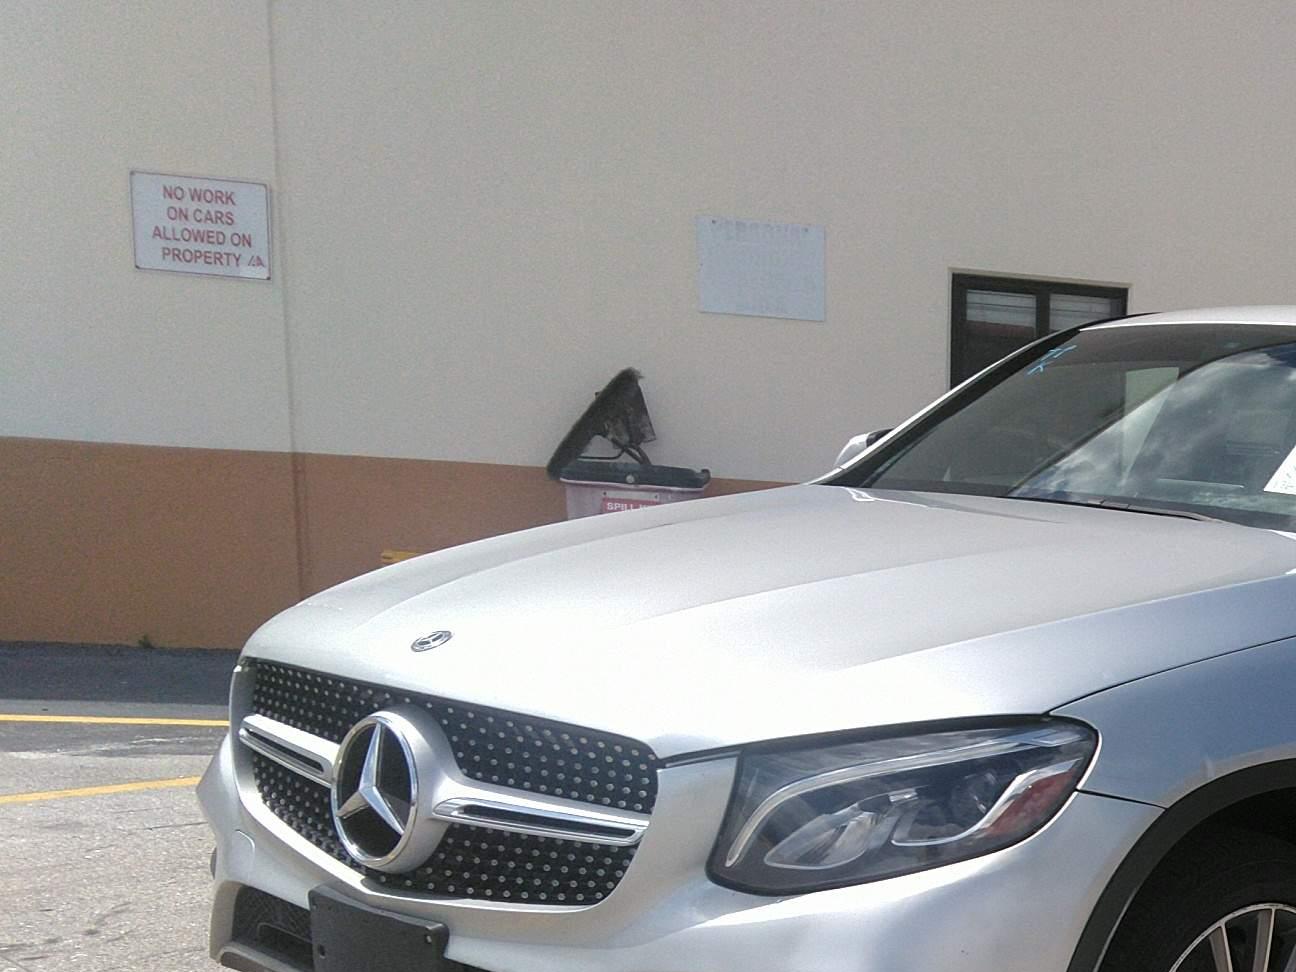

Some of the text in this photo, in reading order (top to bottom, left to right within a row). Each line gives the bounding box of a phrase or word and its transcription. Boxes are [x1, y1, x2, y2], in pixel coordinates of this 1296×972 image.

[162, 185, 236, 205] NO WORK
[167, 206, 234, 226] ON CARS
[152, 225, 252, 248] ALLOWED ON
[162, 247, 241, 267] PROPERTY
